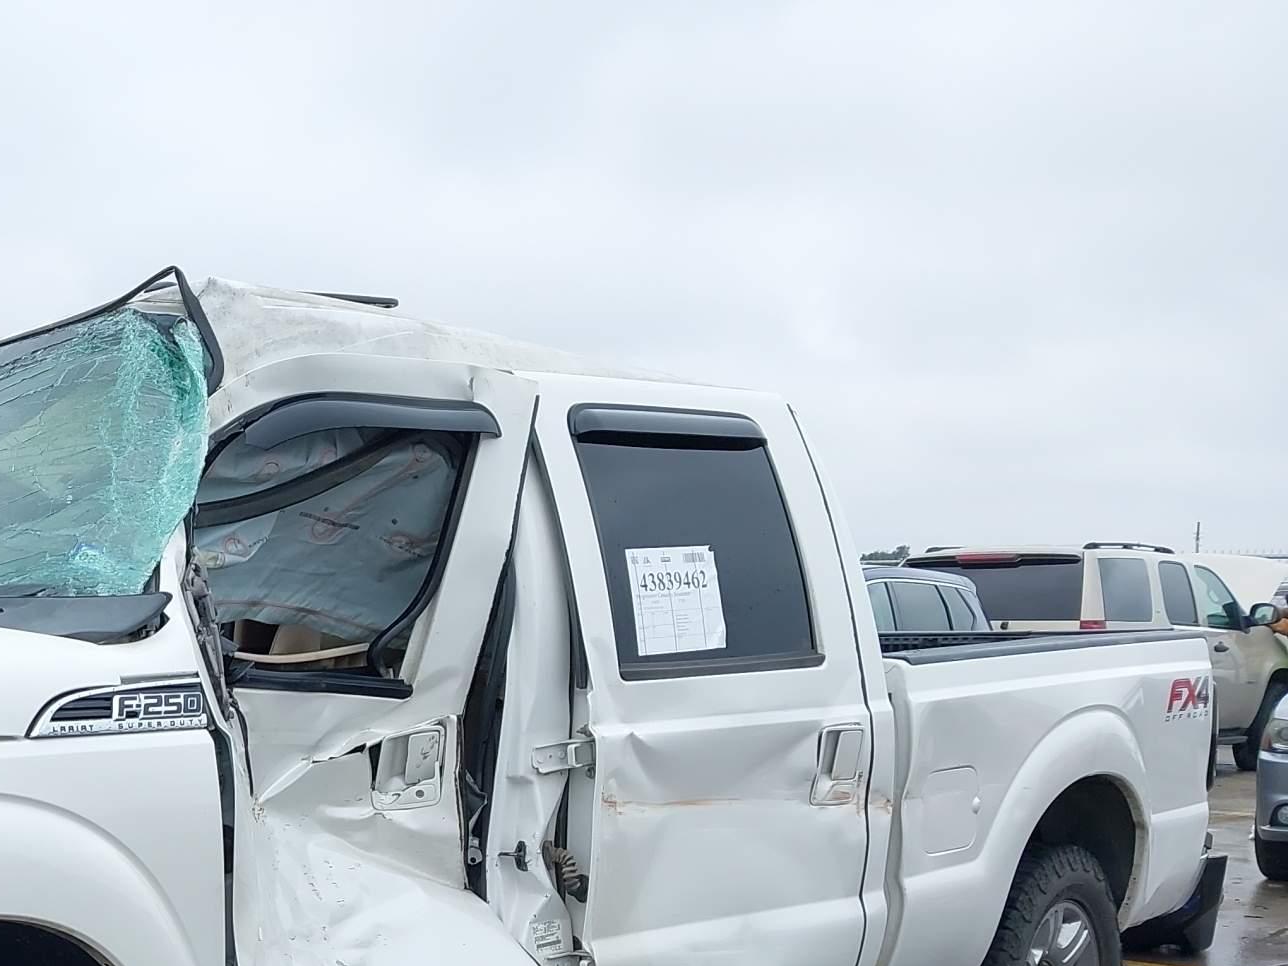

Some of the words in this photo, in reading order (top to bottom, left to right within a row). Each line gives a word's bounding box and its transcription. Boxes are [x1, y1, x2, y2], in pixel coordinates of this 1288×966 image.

[640, 570, 708, 592] 43839462
[1166, 676, 1209, 713] FX4
[113, 691, 203, 721] F-250
[52, 724, 95, 733] LARIAT
[117, 721, 163, 730] SUPER
[169, 719, 204, 728] DUTY
[1165, 713, 1184, 722] OFF
